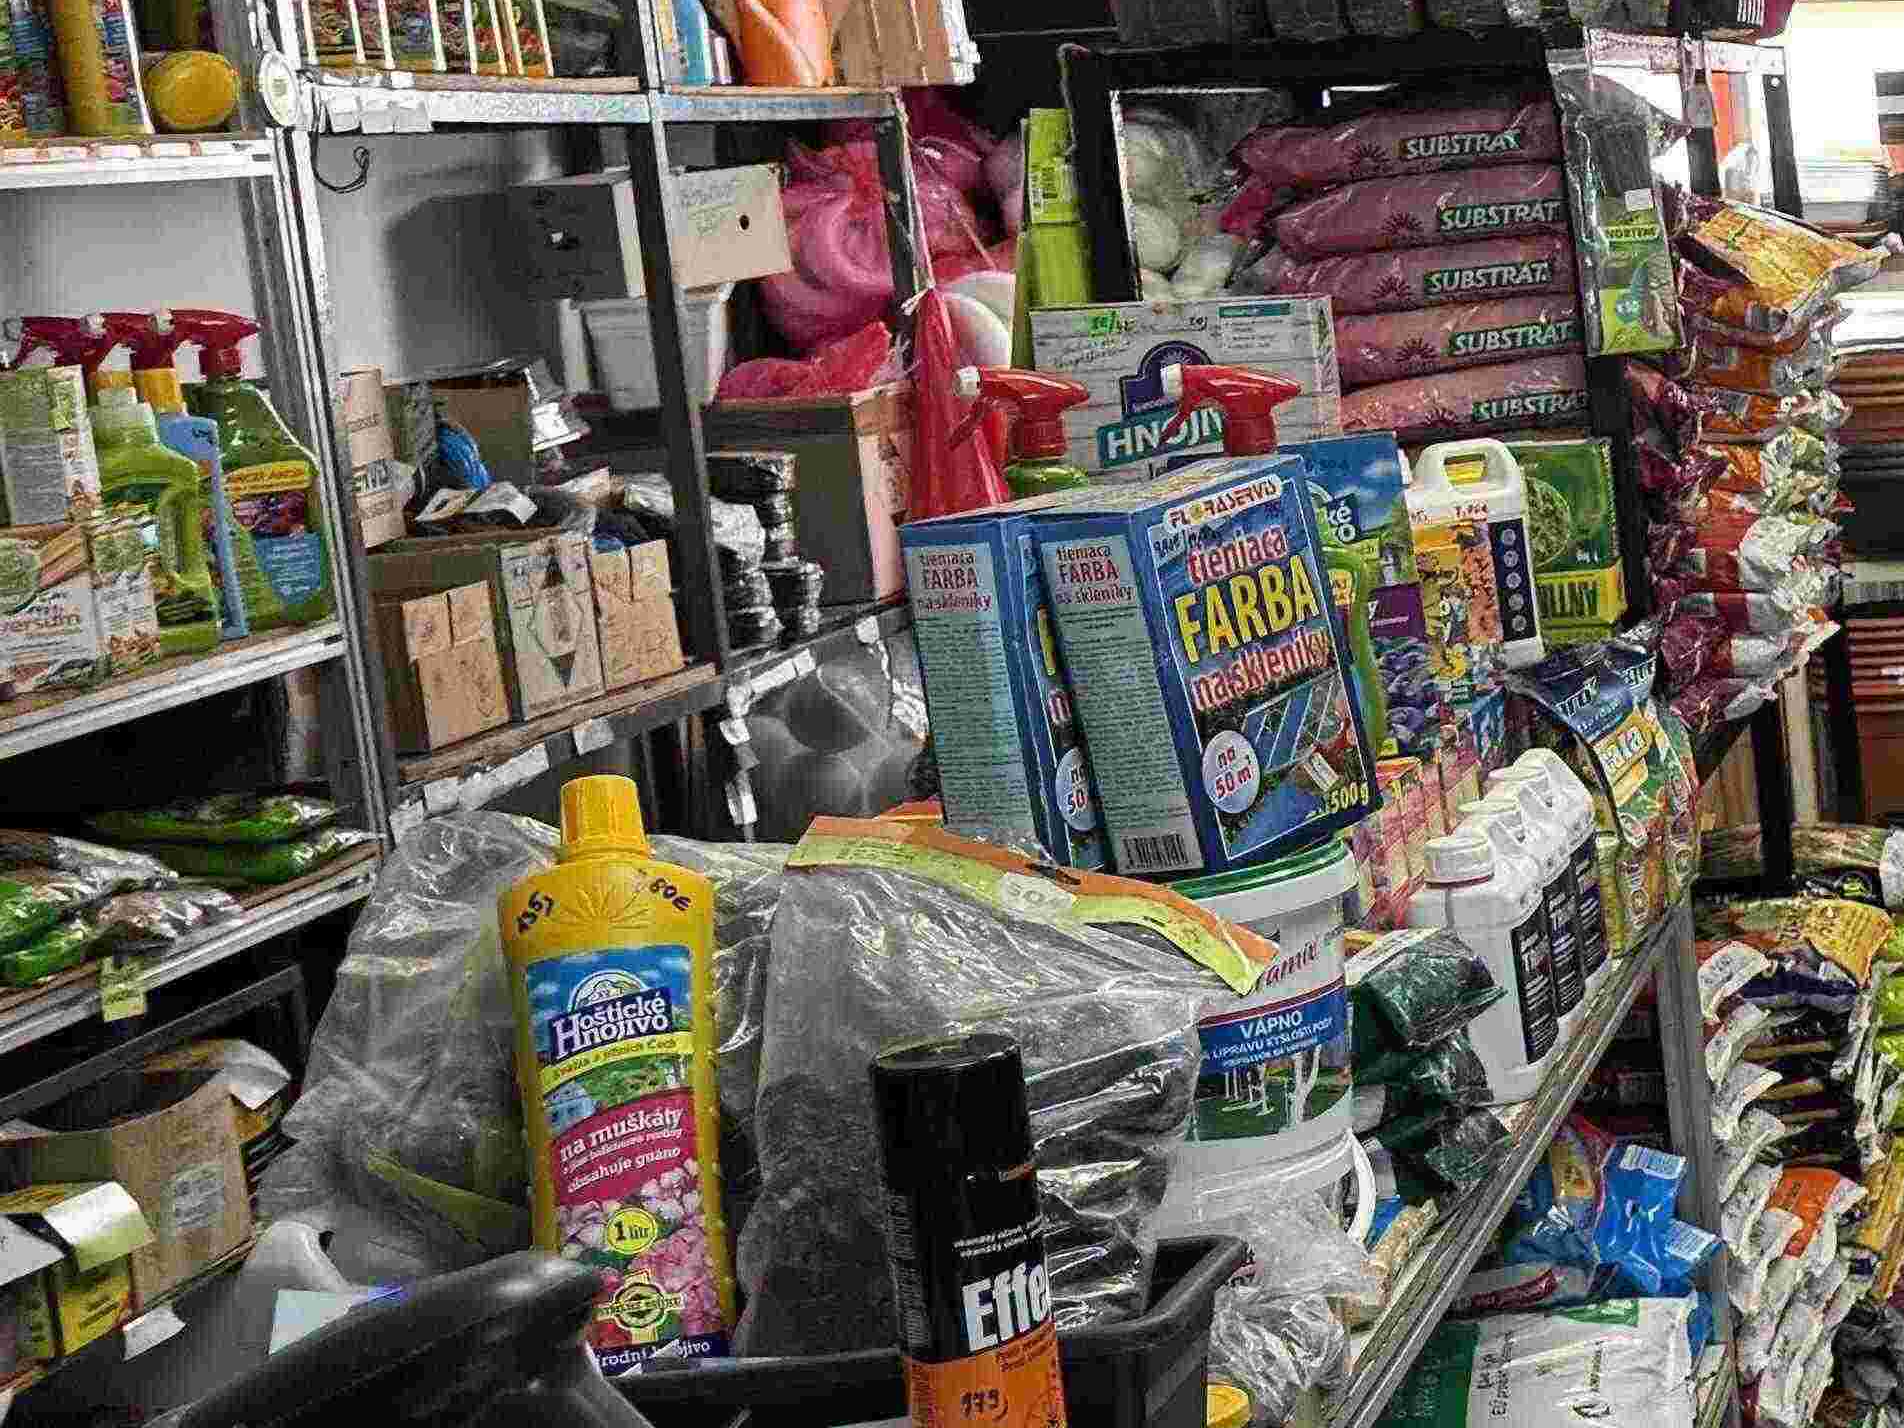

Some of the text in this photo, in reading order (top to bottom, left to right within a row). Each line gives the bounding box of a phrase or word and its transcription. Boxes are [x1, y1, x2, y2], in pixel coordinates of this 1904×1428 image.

[922, 569, 979, 590] FARBA
[1058, 561, 1119, 584] FARBA
[1175, 554, 1320, 663] FARBA
